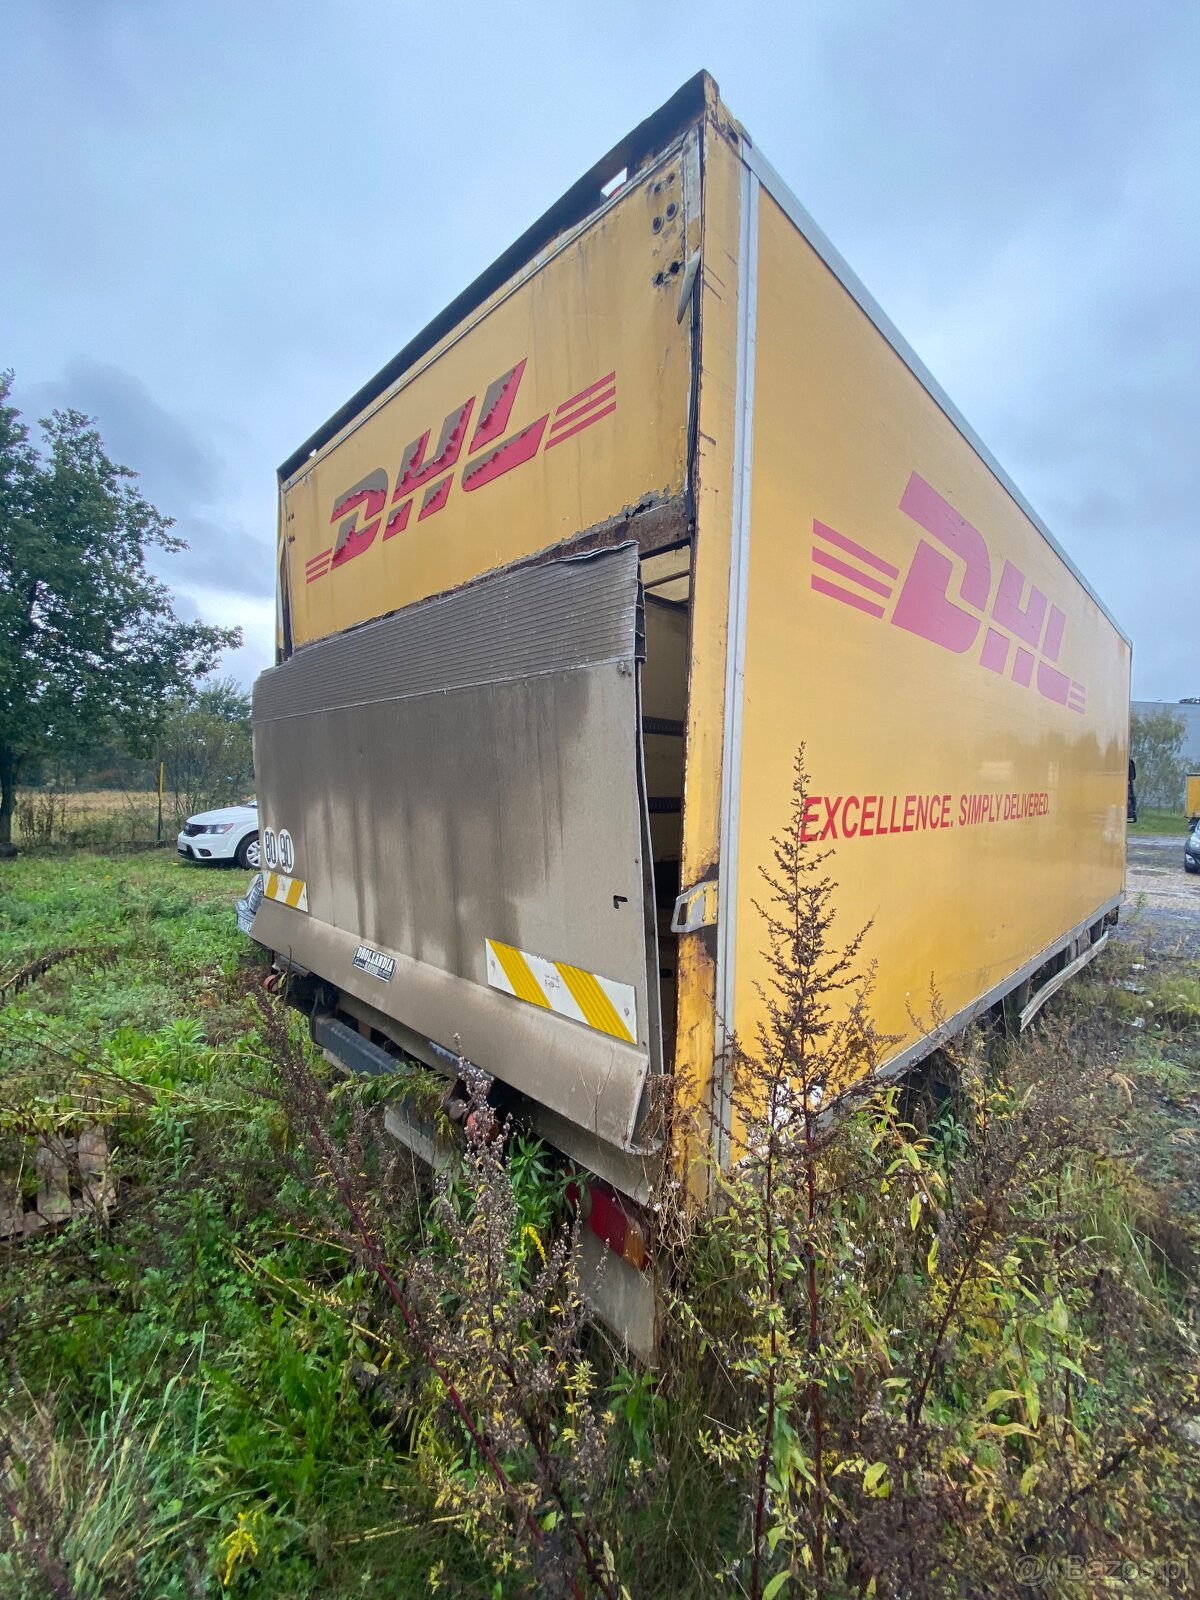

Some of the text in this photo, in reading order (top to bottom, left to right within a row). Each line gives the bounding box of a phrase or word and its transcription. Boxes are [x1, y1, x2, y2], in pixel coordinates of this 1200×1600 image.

[330, 357, 549, 571] DHL
[891, 470, 1071, 707] DHL
[280, 834, 292, 868] 90
[799, 793, 1049, 842] EXCELLENCE. SIMPLY DELIVERED.
